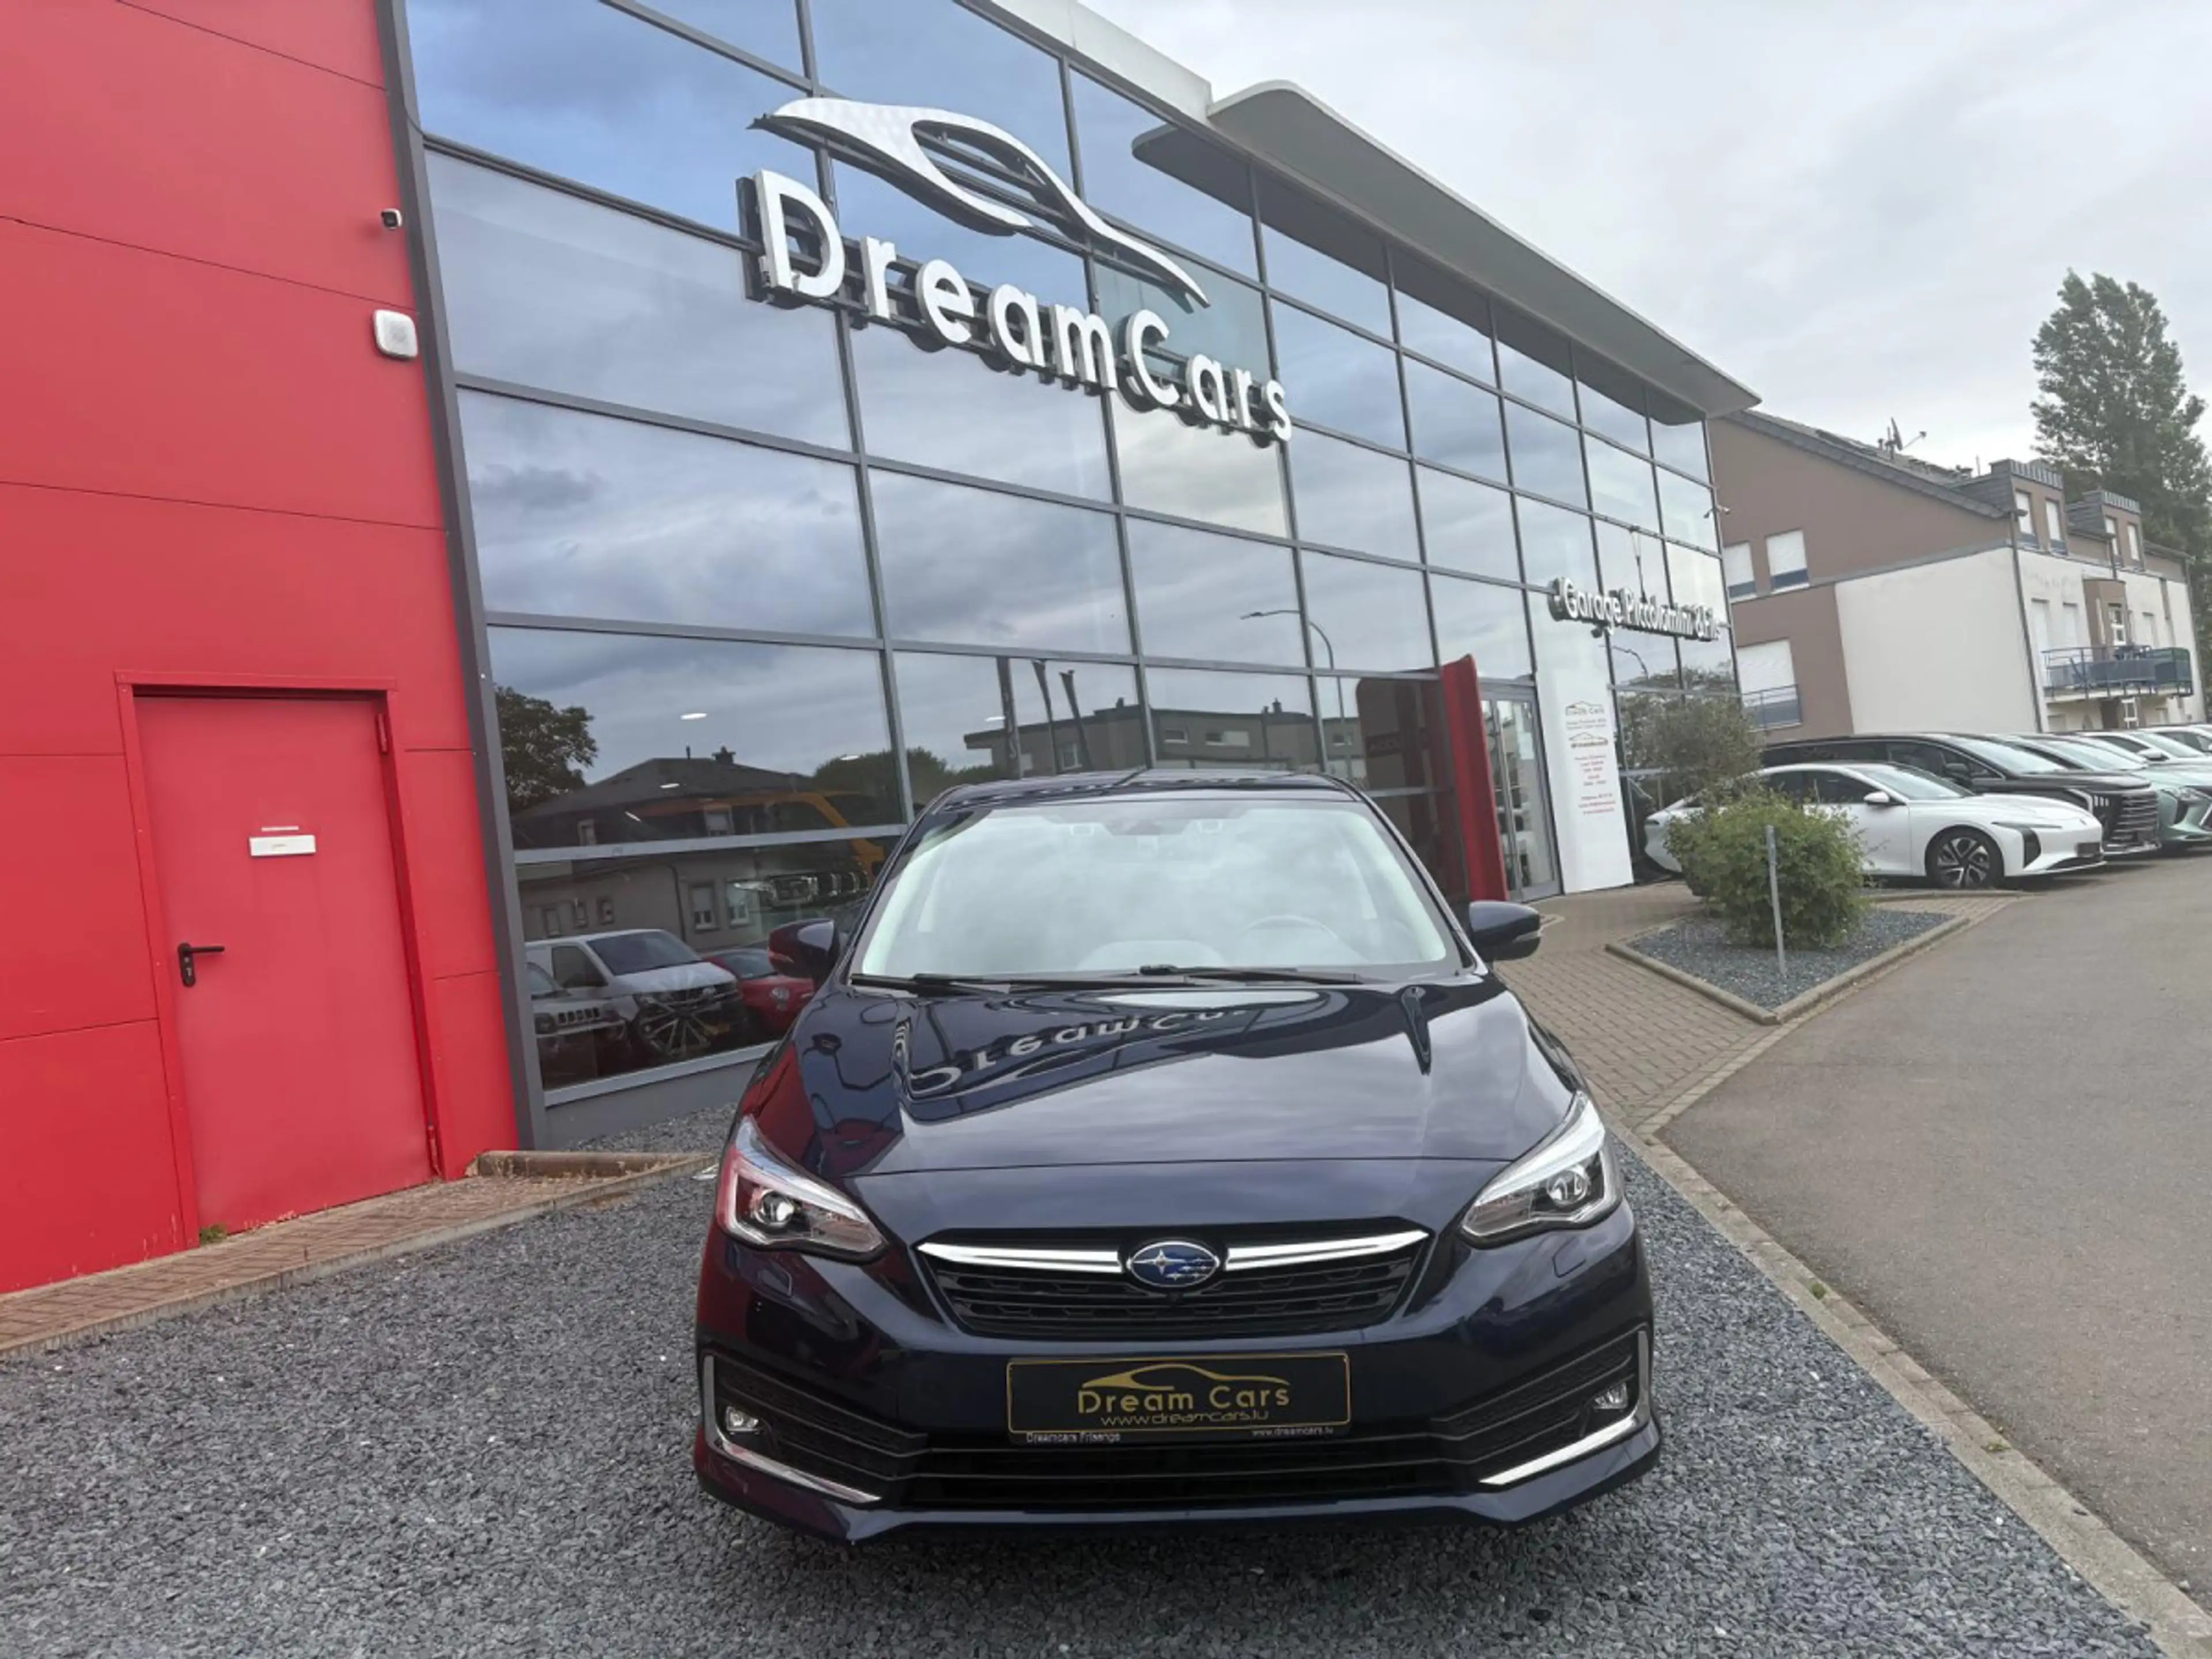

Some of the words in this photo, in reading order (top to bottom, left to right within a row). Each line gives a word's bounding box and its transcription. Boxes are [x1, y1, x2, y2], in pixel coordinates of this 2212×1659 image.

[1561, 576, 1623, 637] Garage
[1077, 1389, 1194, 1414] Dream
[1209, 1385, 1290, 1408] Cars
